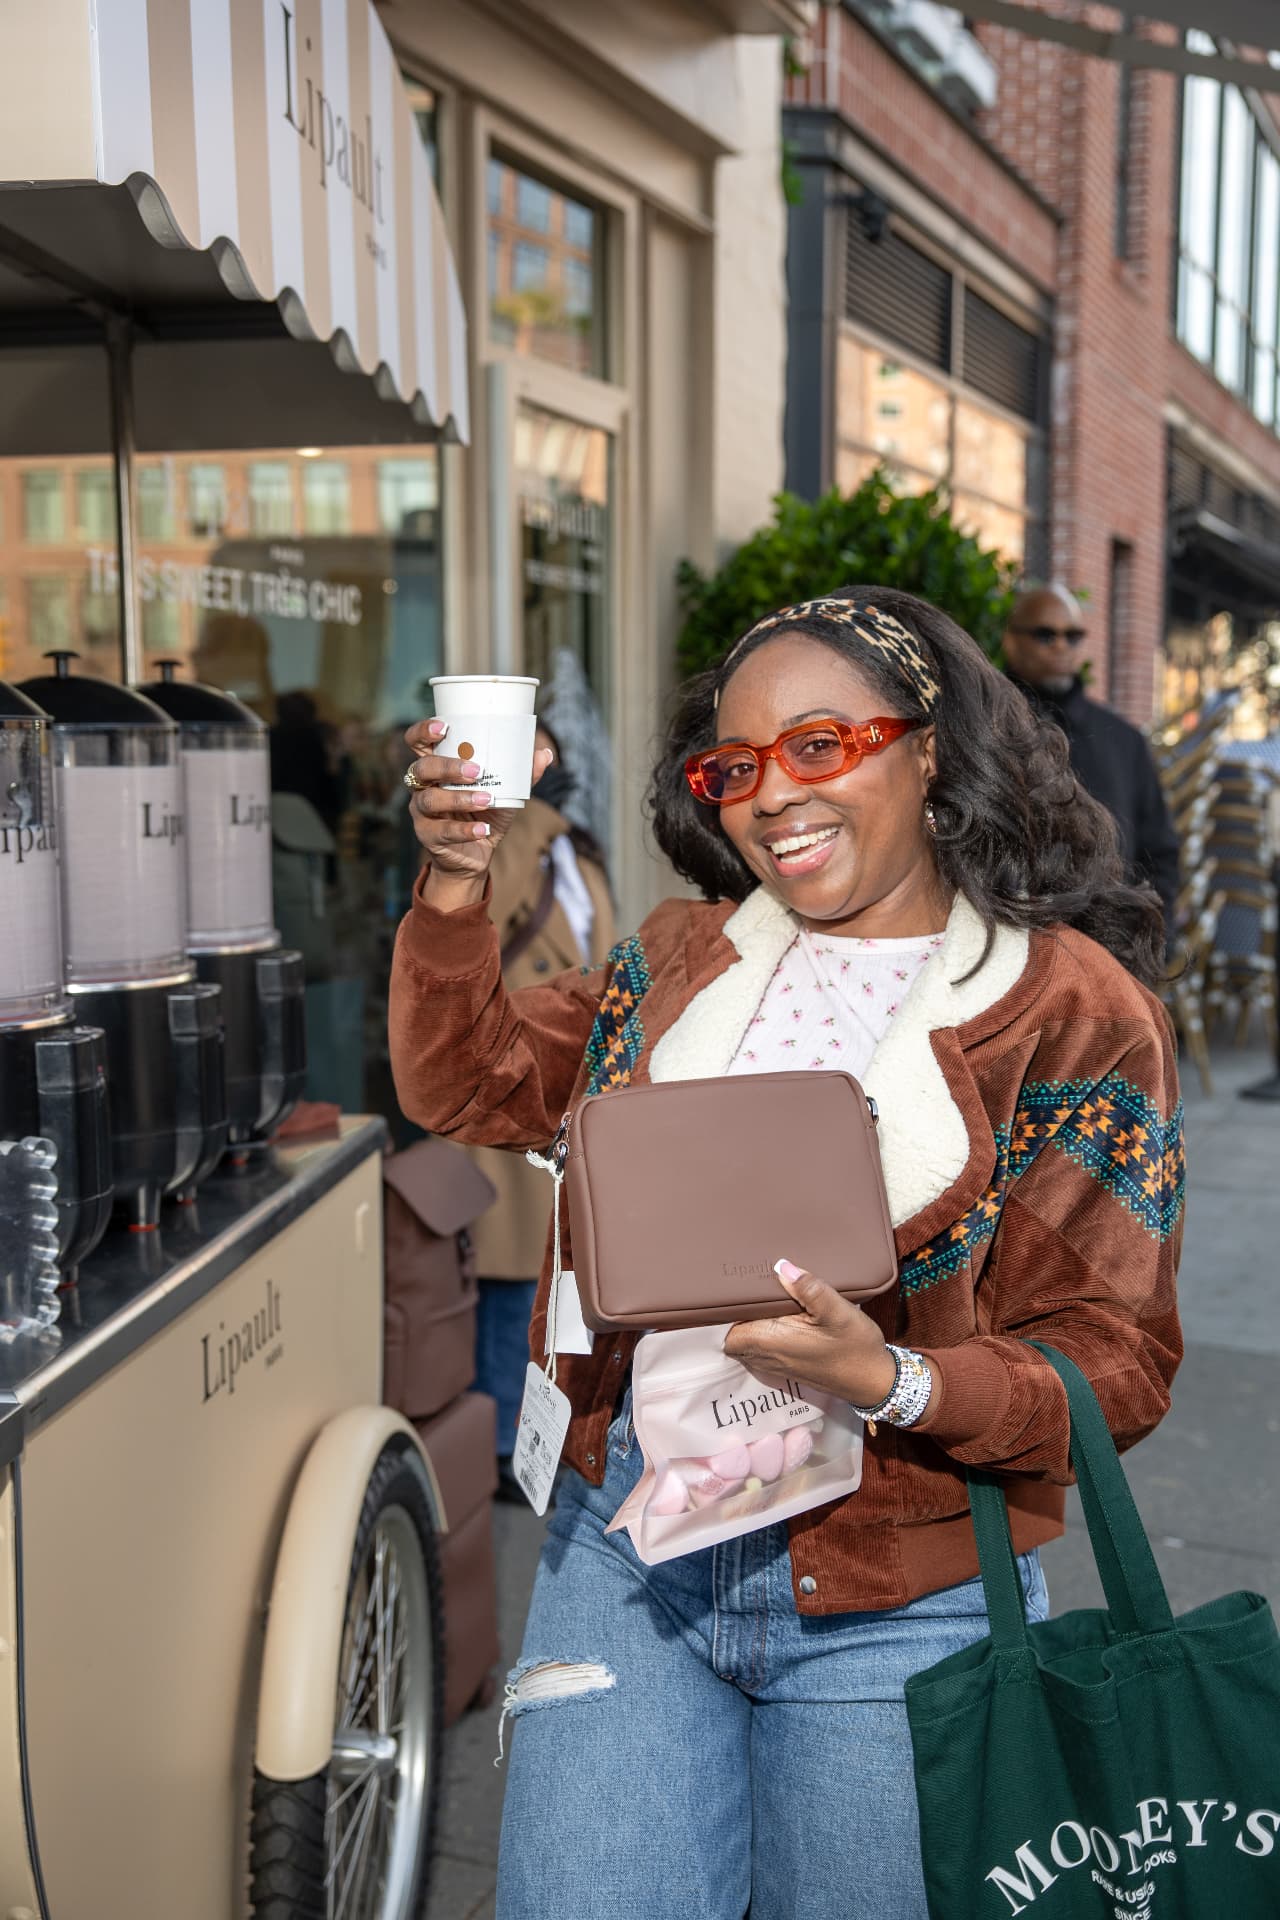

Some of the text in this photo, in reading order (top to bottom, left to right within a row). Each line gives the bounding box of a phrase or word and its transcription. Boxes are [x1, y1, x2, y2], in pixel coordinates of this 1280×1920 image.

[280, 2, 384, 225] Lipault
[308, 579, 362, 626] CHIC
[200, 1279, 282, 1405] Lipault
[711, 1378, 806, 1429] Lipault
[790, 1405, 810, 1418] PARIS
[1144, 1849, 1177, 1874] OOKS
